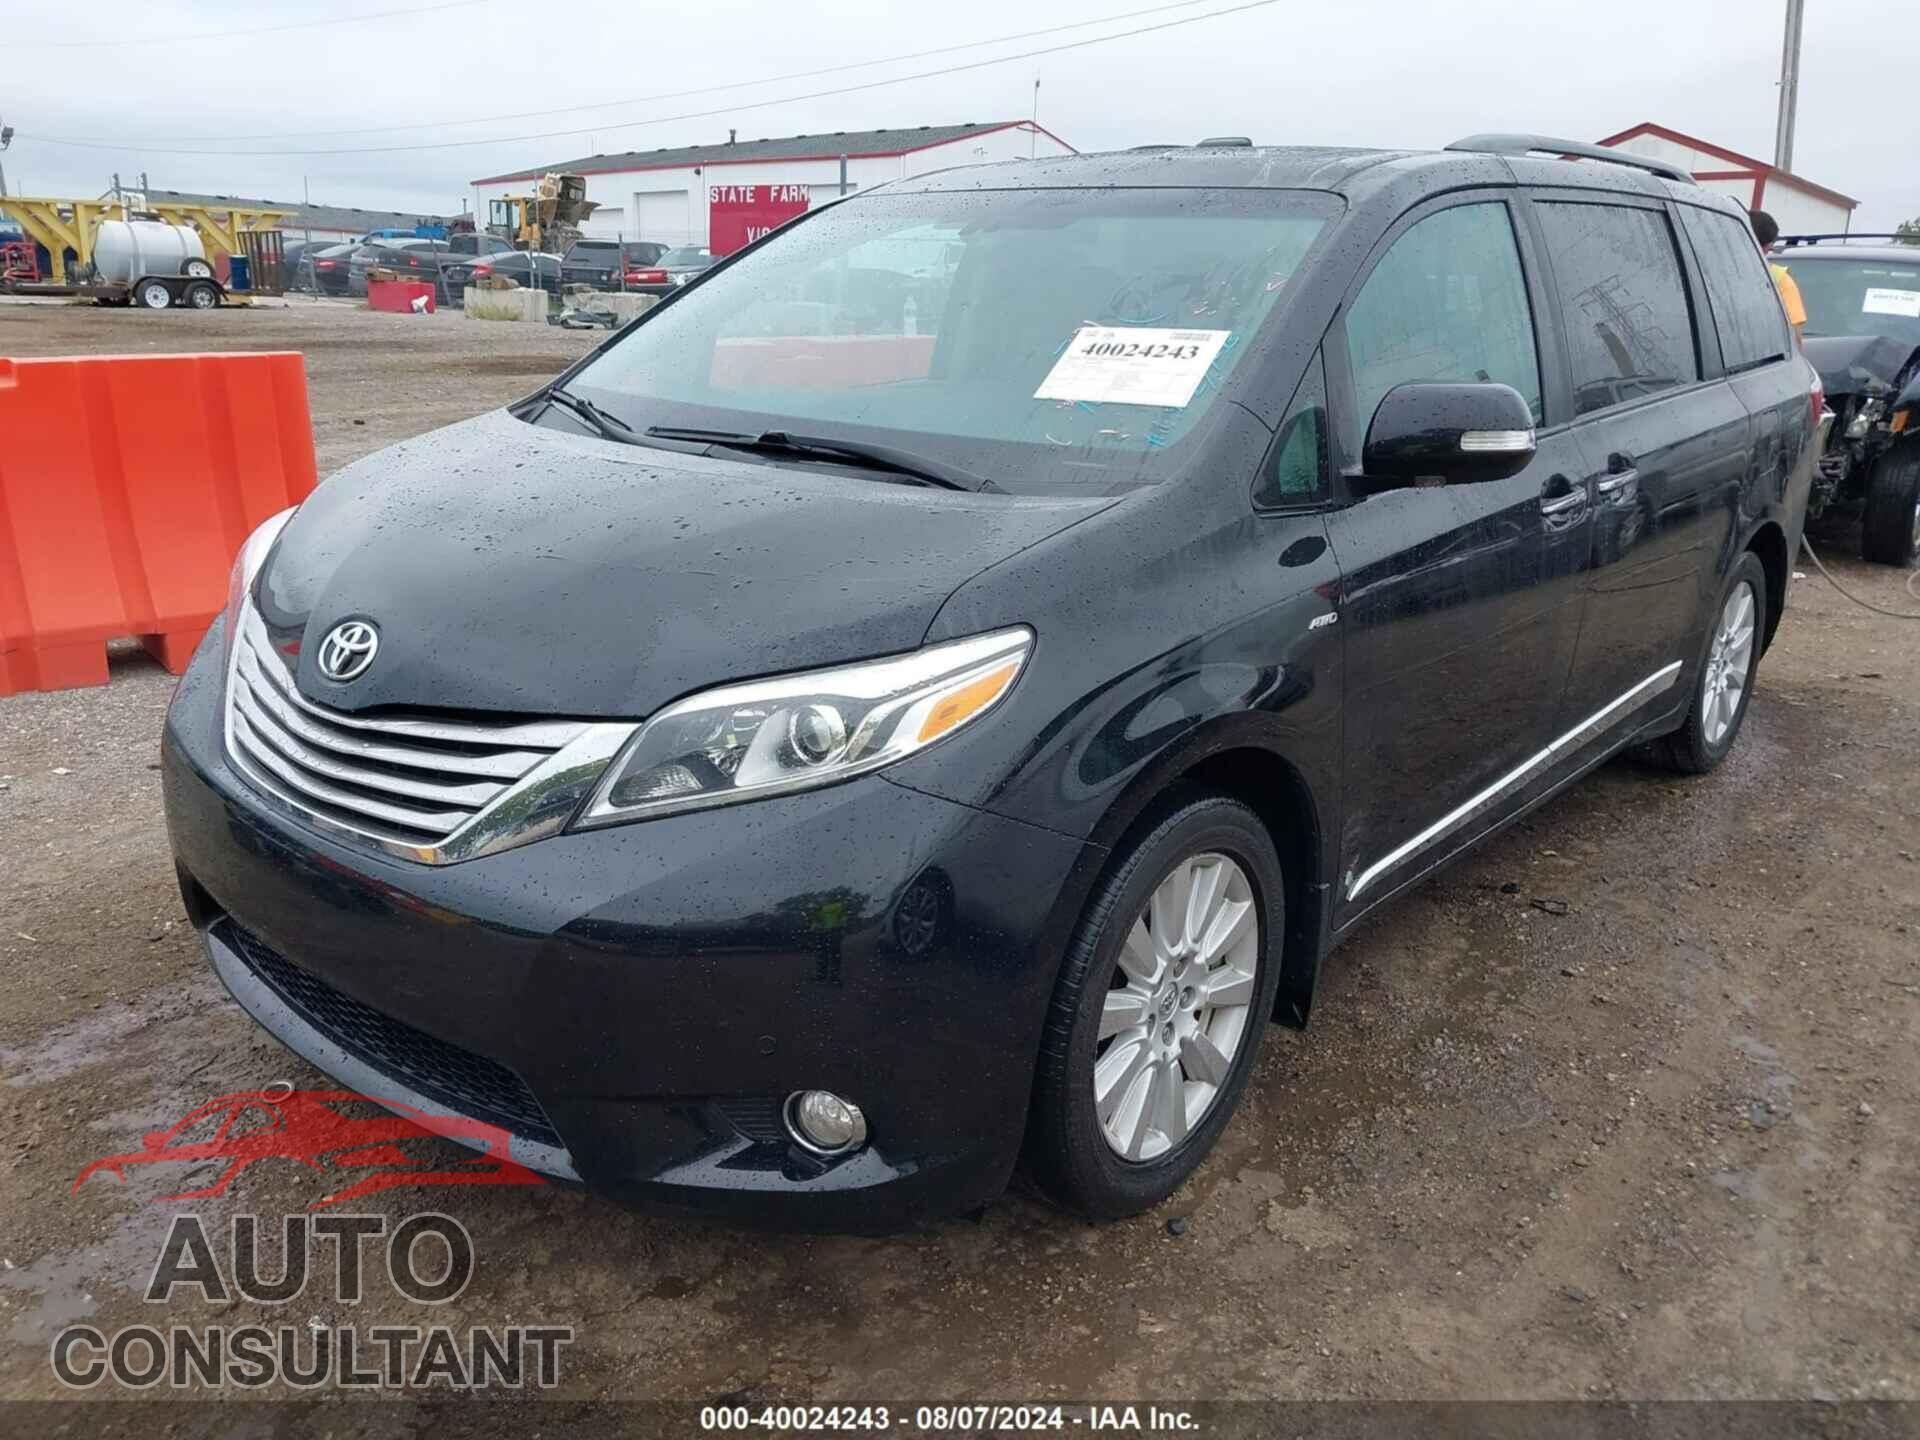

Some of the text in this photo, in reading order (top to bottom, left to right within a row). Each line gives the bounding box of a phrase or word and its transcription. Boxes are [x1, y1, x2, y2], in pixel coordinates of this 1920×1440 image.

[711, 186, 808, 203] STATE FARM
[1081, 342, 1200, 360] 40024243
